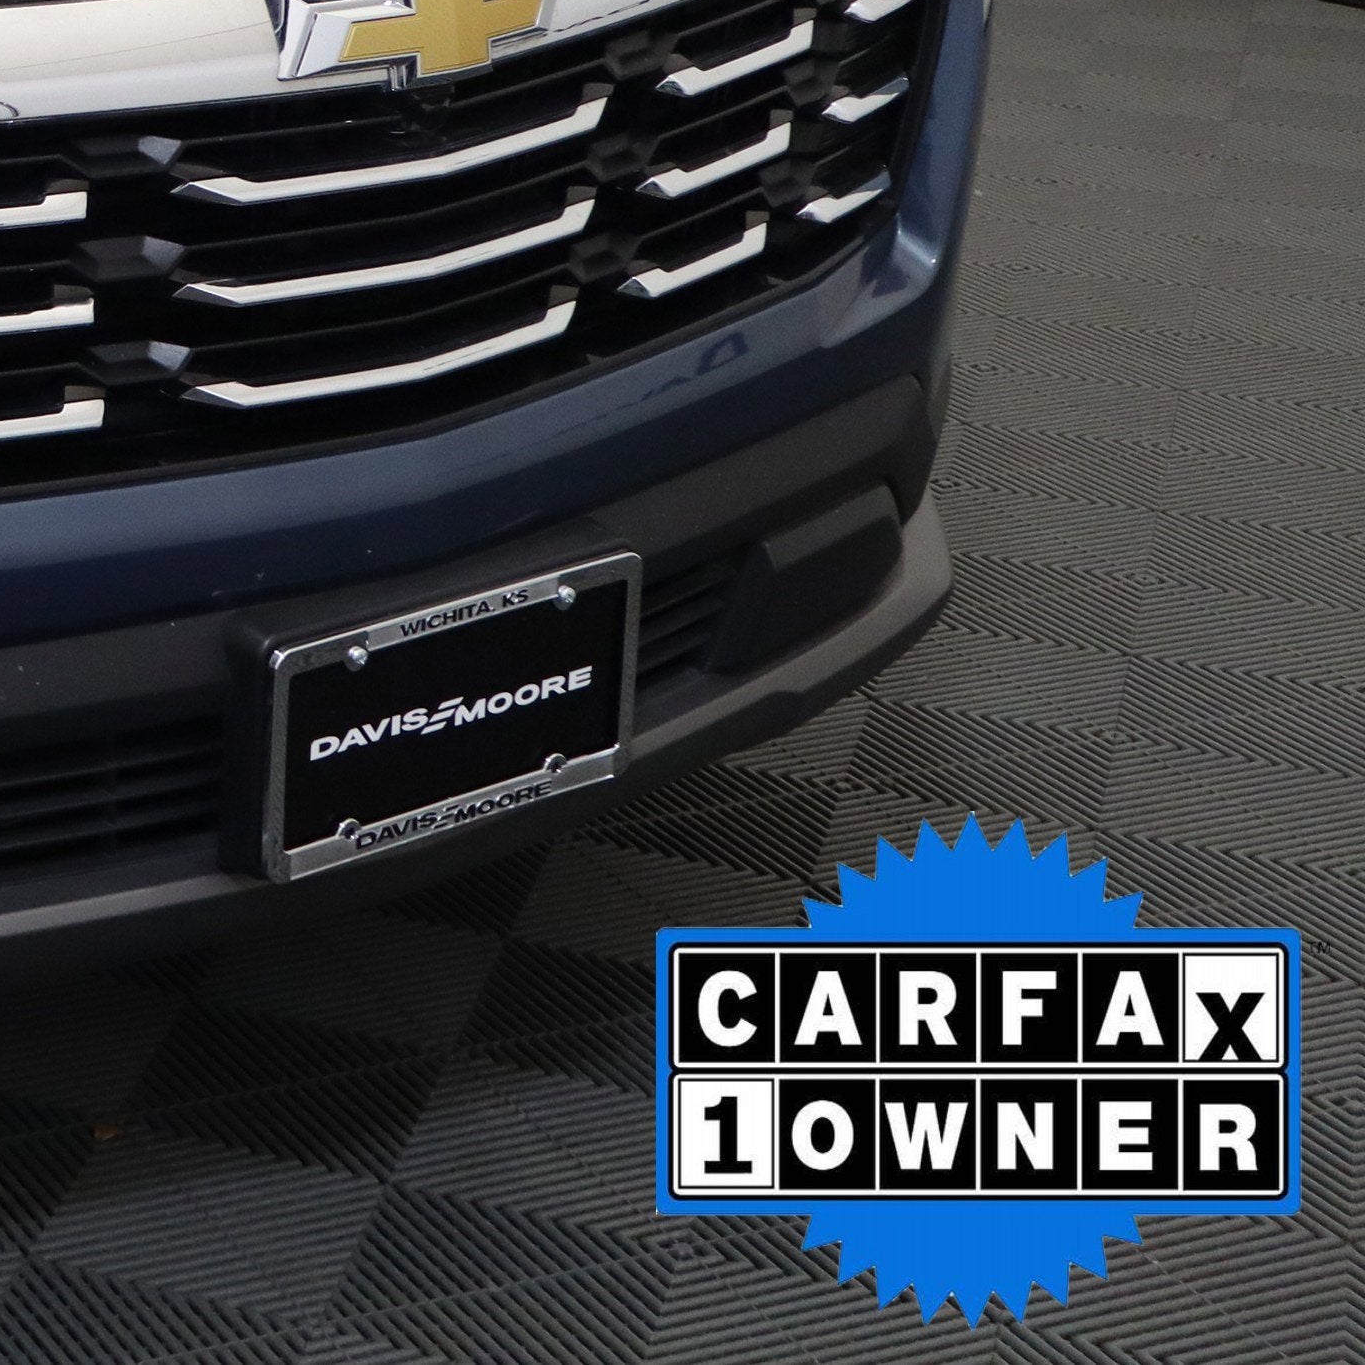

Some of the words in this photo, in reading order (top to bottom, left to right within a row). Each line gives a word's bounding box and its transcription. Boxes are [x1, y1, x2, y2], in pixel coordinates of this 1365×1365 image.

[501, 589, 529, 608] KS
[310, 707, 429, 761] DAVIS
[454, 666, 592, 726] MOORE
[355, 812, 437, 849] DAVIS
[454, 780, 552, 823] MOORE
